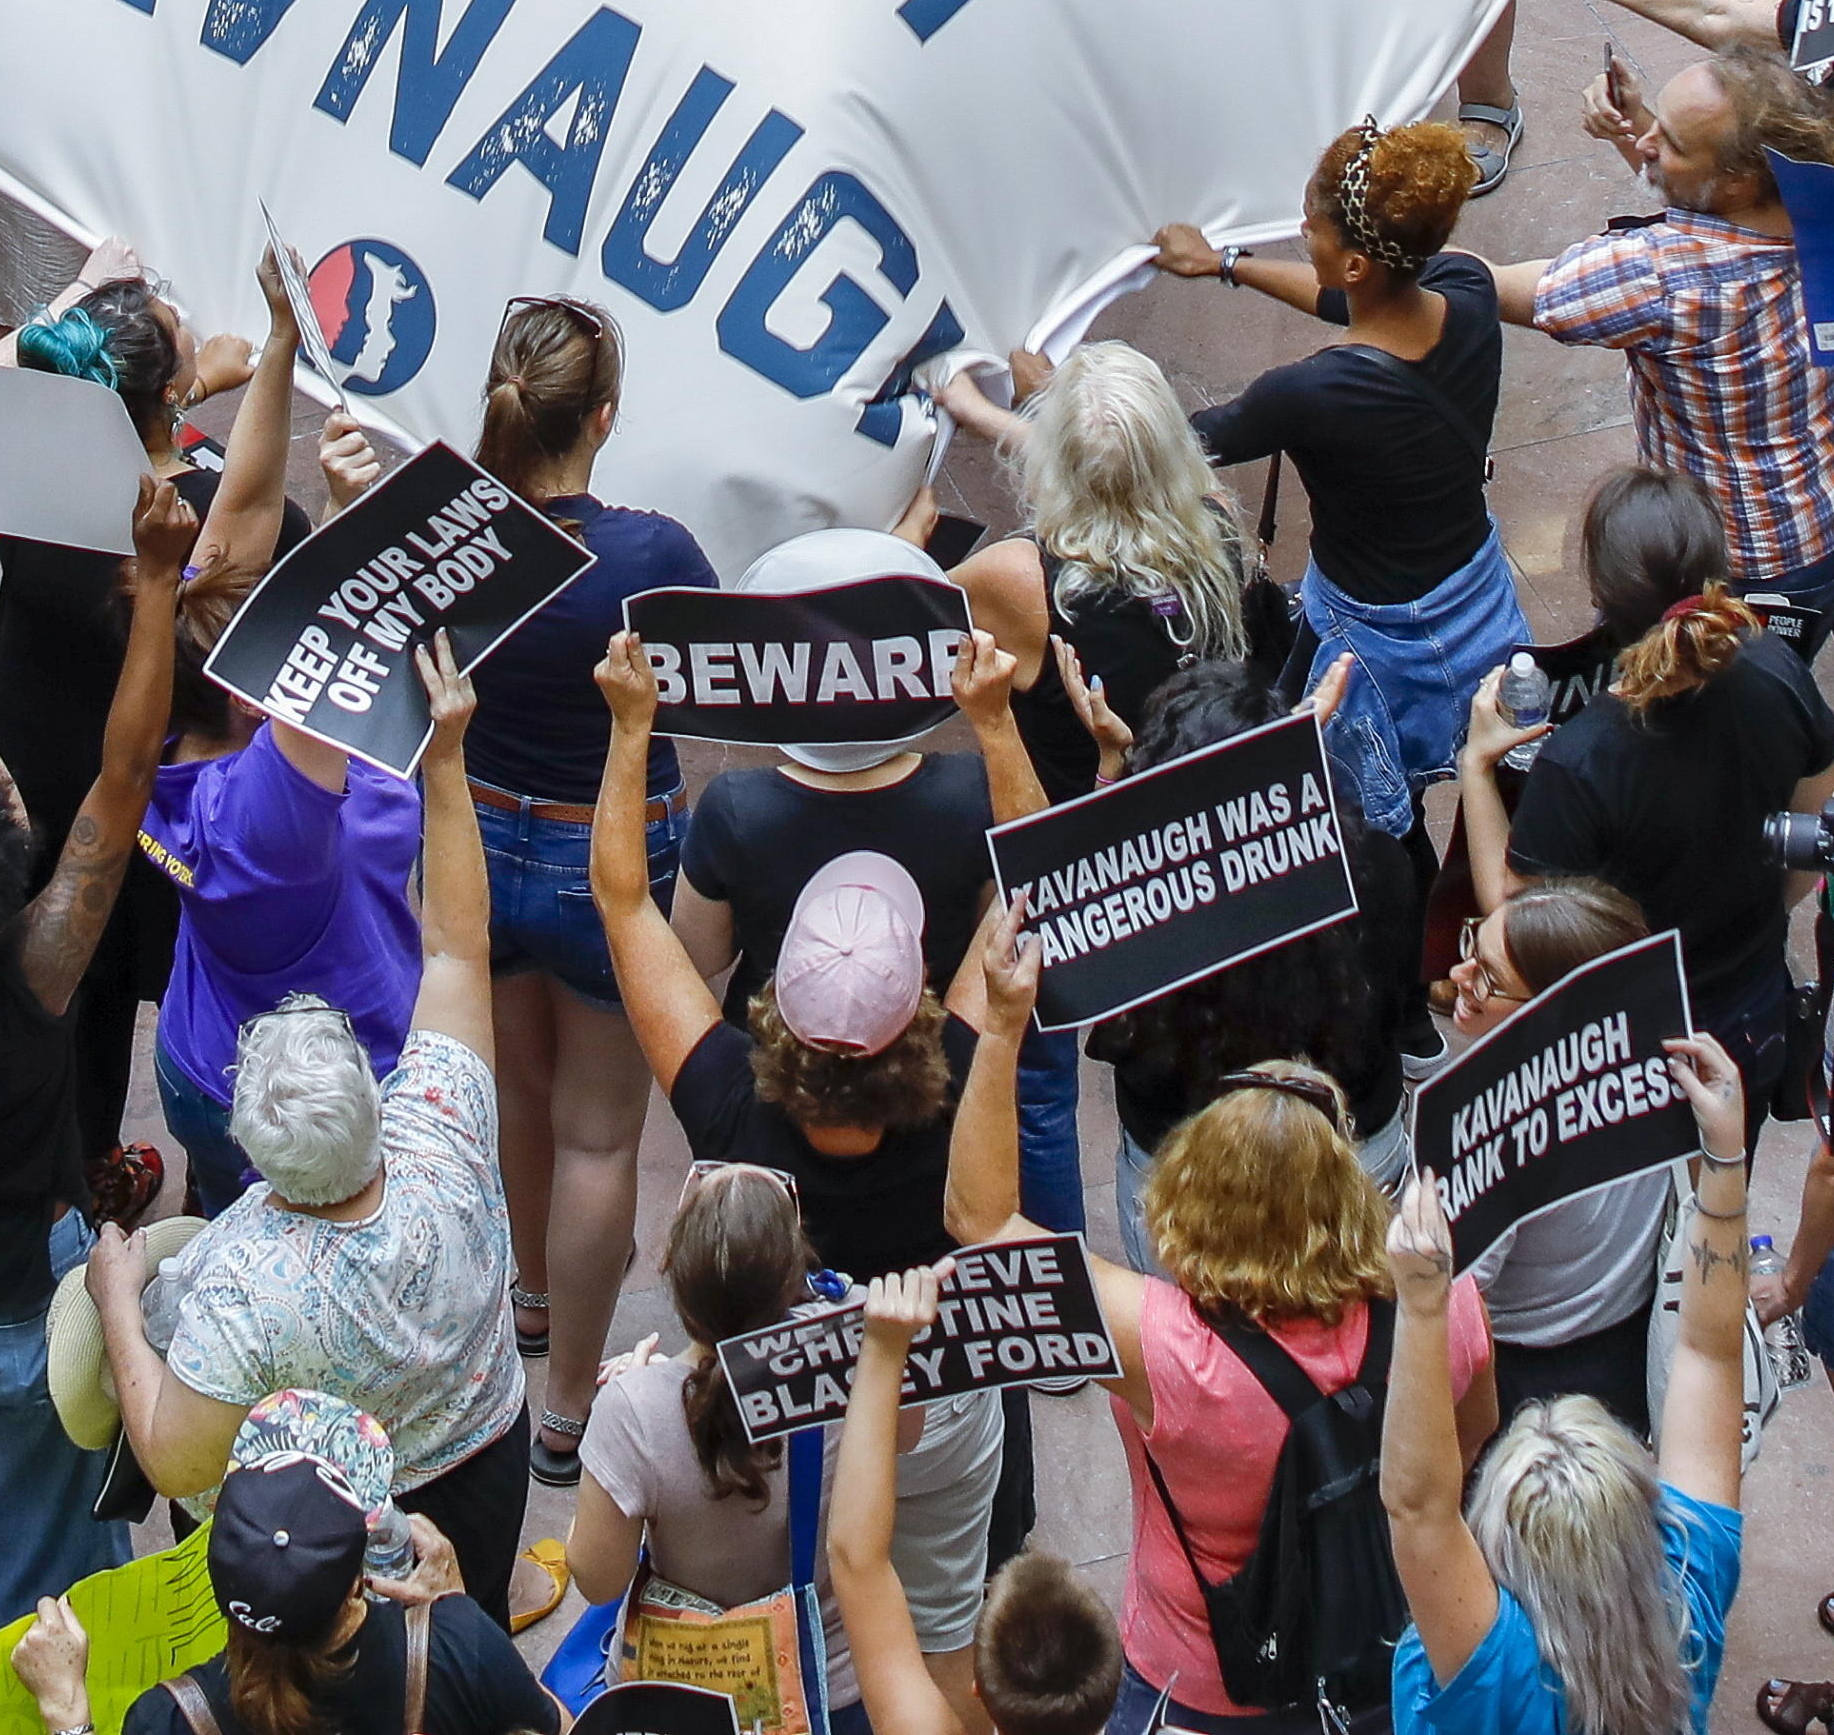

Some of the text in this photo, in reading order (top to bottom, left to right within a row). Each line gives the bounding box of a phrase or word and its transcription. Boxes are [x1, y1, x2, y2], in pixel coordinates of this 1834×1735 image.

[1798, 0, 1824, 34] IS
[264, 476, 508, 724] KEEP YOUR LAWS
[326, 529, 513, 714] OFF MY BODY
[1769, 614, 1805, 629] PEOPLE
[1013, 771, 1325, 922] KAVANAUGH WAS A
[1223, 814, 1341, 886] DRUNK
[1449, 1011, 1632, 1157] KAVANAUGH
[1510, 1122, 1548, 1166] TO
[968, 1328, 1110, 1380] FORD
